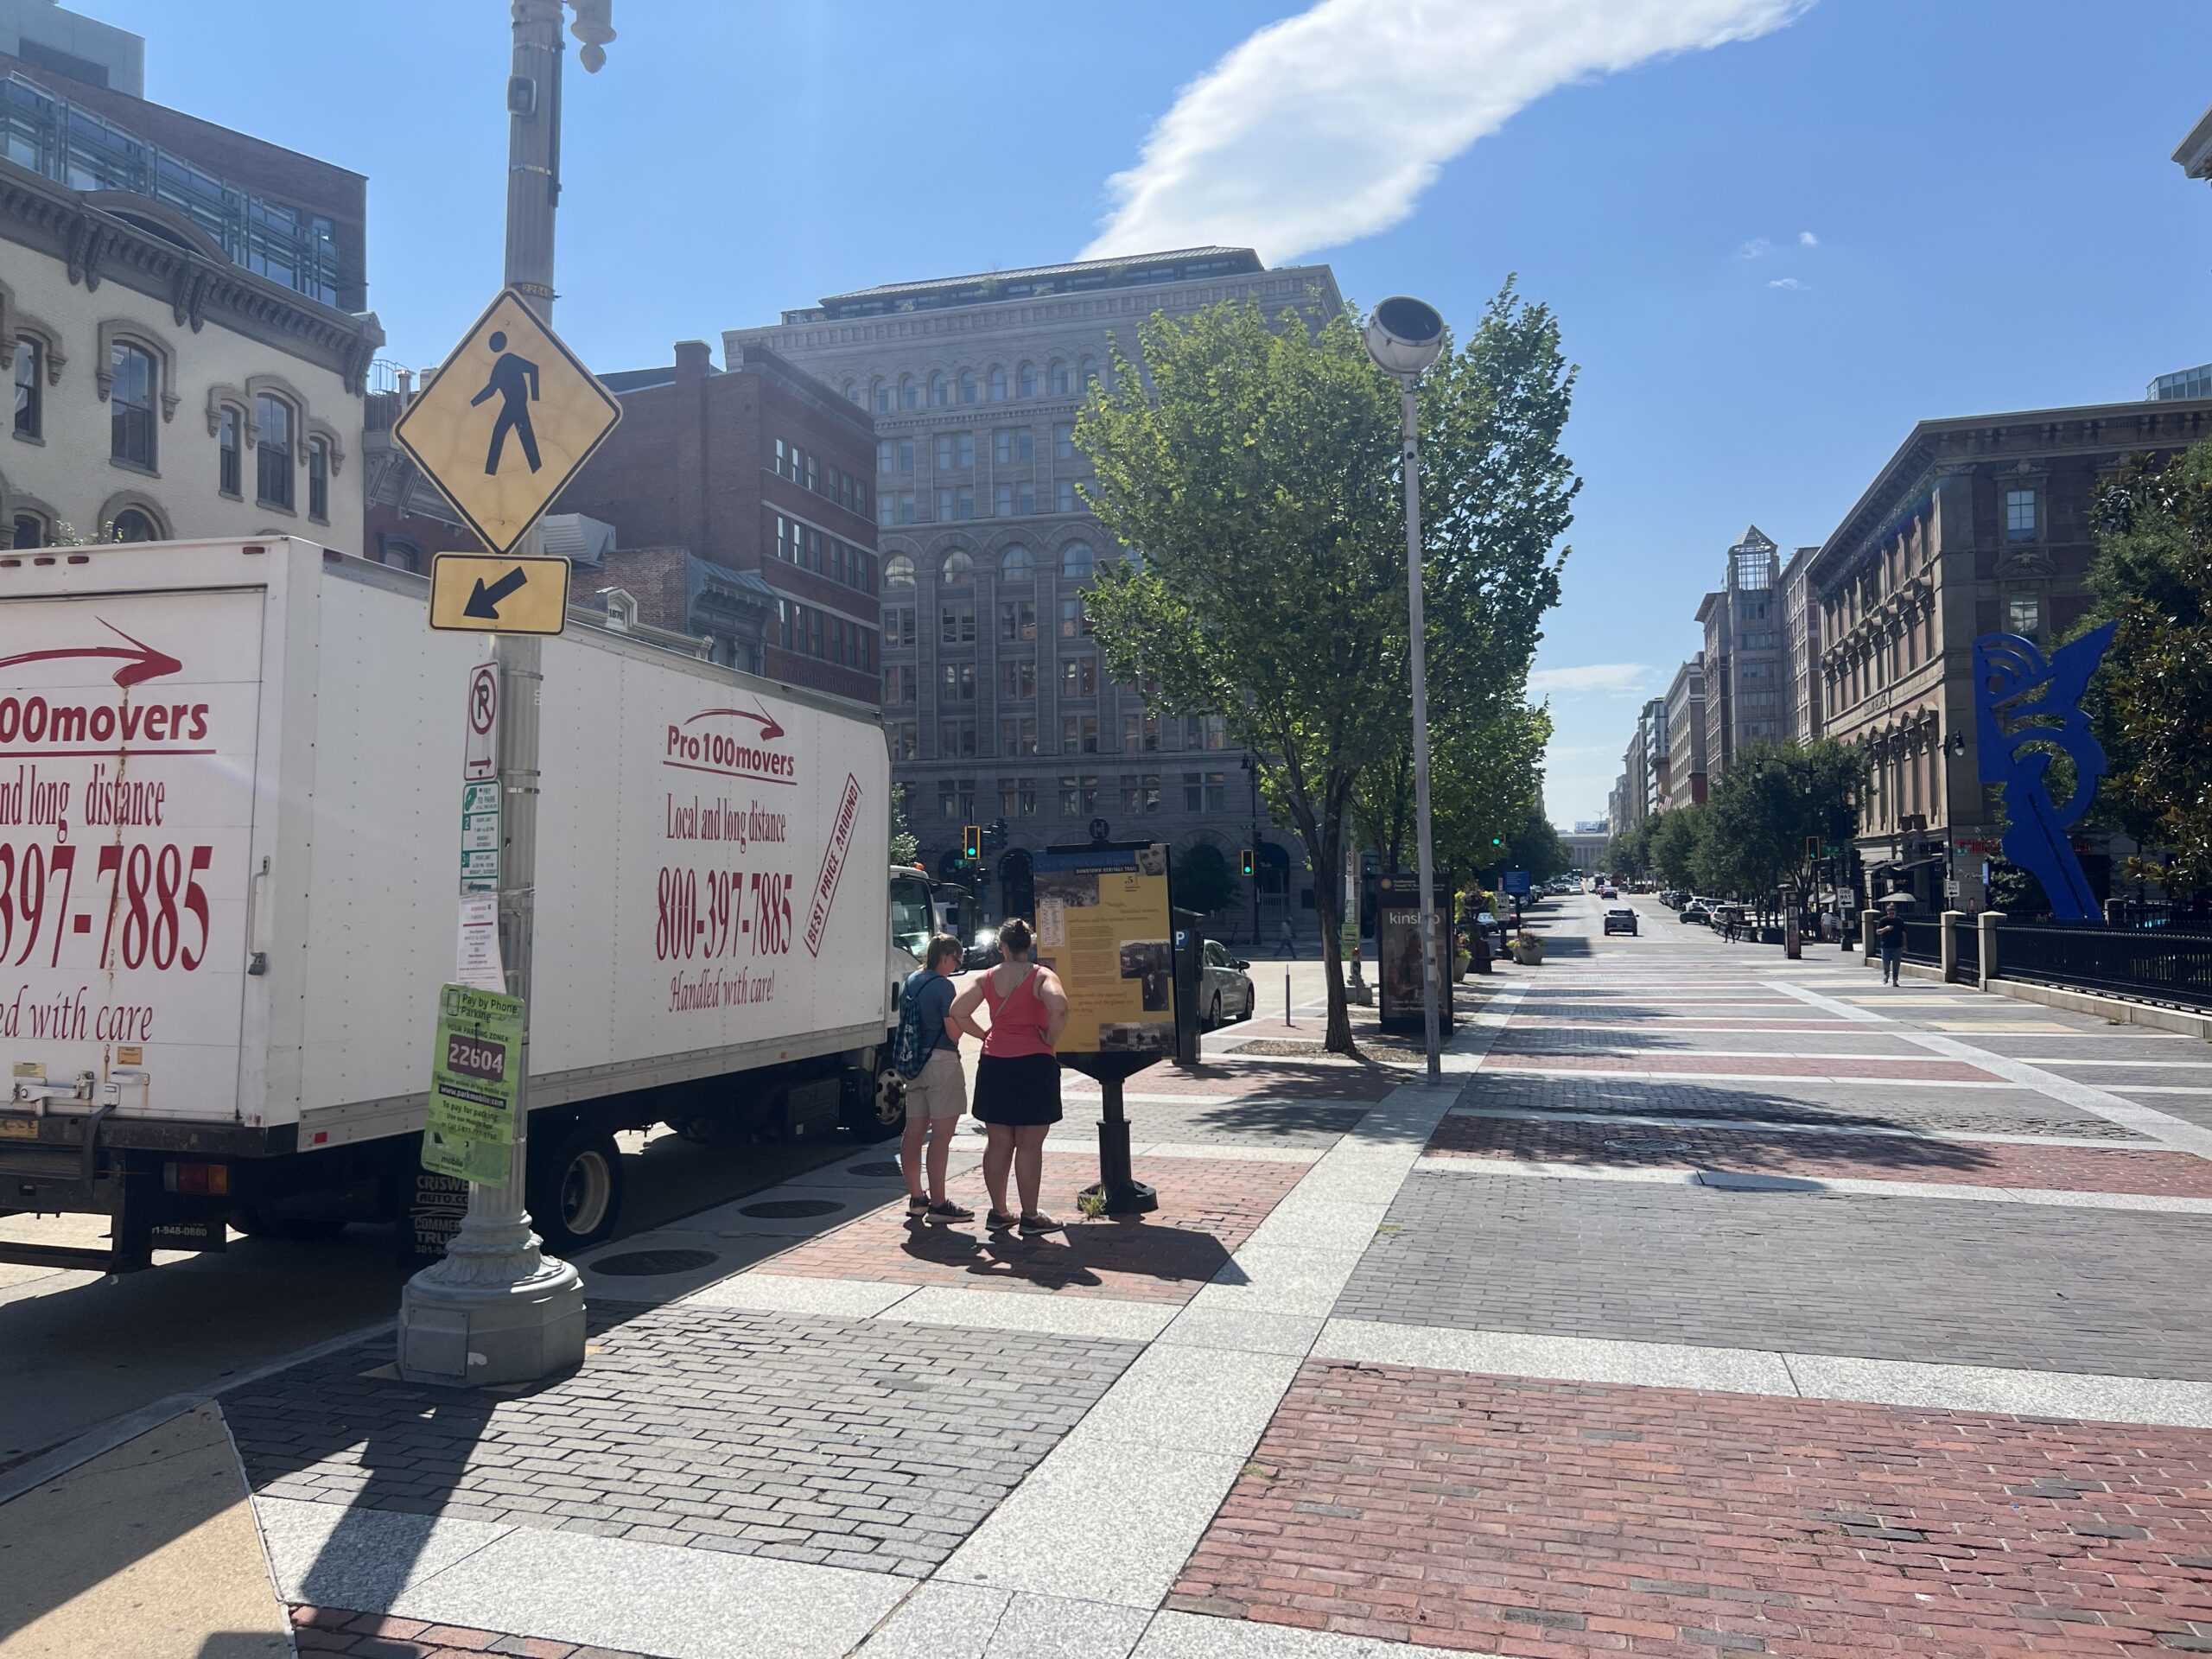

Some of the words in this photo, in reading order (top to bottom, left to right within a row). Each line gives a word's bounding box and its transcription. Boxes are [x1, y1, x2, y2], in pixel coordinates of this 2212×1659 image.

[667, 725, 794, 777] Pro100movers
[28, 765, 70, 843] long
[86, 763, 165, 826] distance
[666, 793, 698, 840] Local
[702, 798, 721, 841] and
[723, 798, 747, 854] long
[749, 800, 785, 843] distance
[807, 899, 824, 945] BEST
[821, 849, 839, 900] PRICE
[835, 785, 858, 852] AROUND
[656, 867, 792, 961] 800-397-7885
[1176, 931, 1185, 945] P
[462, 994, 477, 1007] Pay
[479, 997, 489, 1009] by
[491, 999, 518, 1014] Phone
[669, 969, 723, 1013] Handled
[723, 965, 748, 1007] with
[750, 969, 775, 1003] care!
[29, 986, 88, 1040] with
[96, 1006, 153, 1041] care
[448, 1023, 462, 1033] YOUR
[461, 1006, 492, 1023] Parking
[449, 1043, 503, 1073] 22604
[441, 1085, 505, 1107] www.parkmobile.com
[442, 1100, 449, 1109] To
[451, 1103, 462, 1114] pay
[463, 1105, 473, 1114] for
[441, 1156, 464, 1167] mobile
